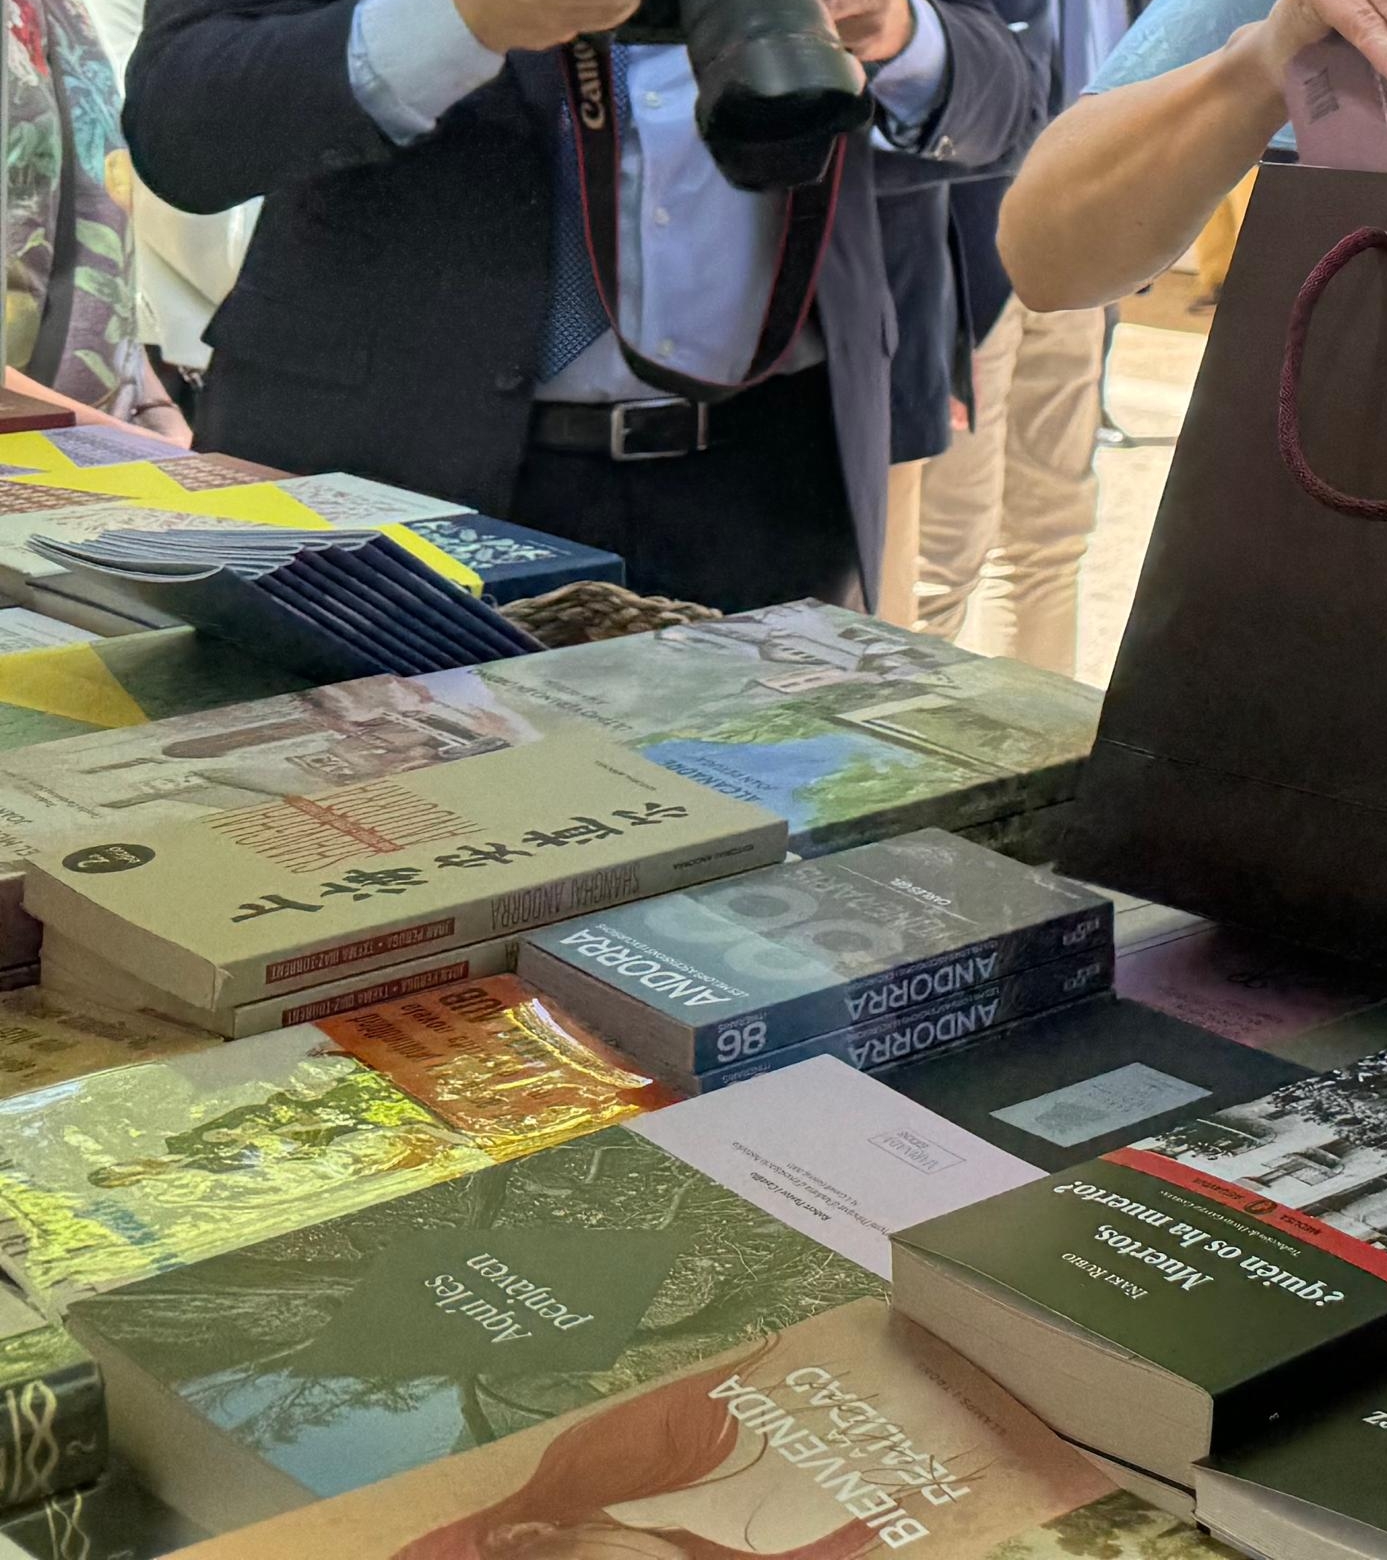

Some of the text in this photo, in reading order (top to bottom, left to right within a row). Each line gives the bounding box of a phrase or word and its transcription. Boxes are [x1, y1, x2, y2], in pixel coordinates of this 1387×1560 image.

[572, 40, 606, 131] Cano
[490, 882, 566, 931] ANDORRA
[559, 927, 731, 1006] ANDORRA
[843, 951, 998, 1022] ANDORRA
[716, 1021, 767, 1062] 86
[847, 998, 999, 1070] ANDORRA
[1053, 1180, 1174, 1231] muerto?
[1167, 1221, 1211, 1250] ha
[1061, 1252, 1104, 1279] RUBIO
[1092, 1224, 1214, 1292] Muertos,
[1203, 1239, 1242, 1262] os
[1238, 1255, 1345, 1307] ¿quién
[424, 1274, 533, 1343] Aquí les
[466, 1253, 595, 1330] penjaven
[707, 1373, 930, 1549] BIENVENIDA
